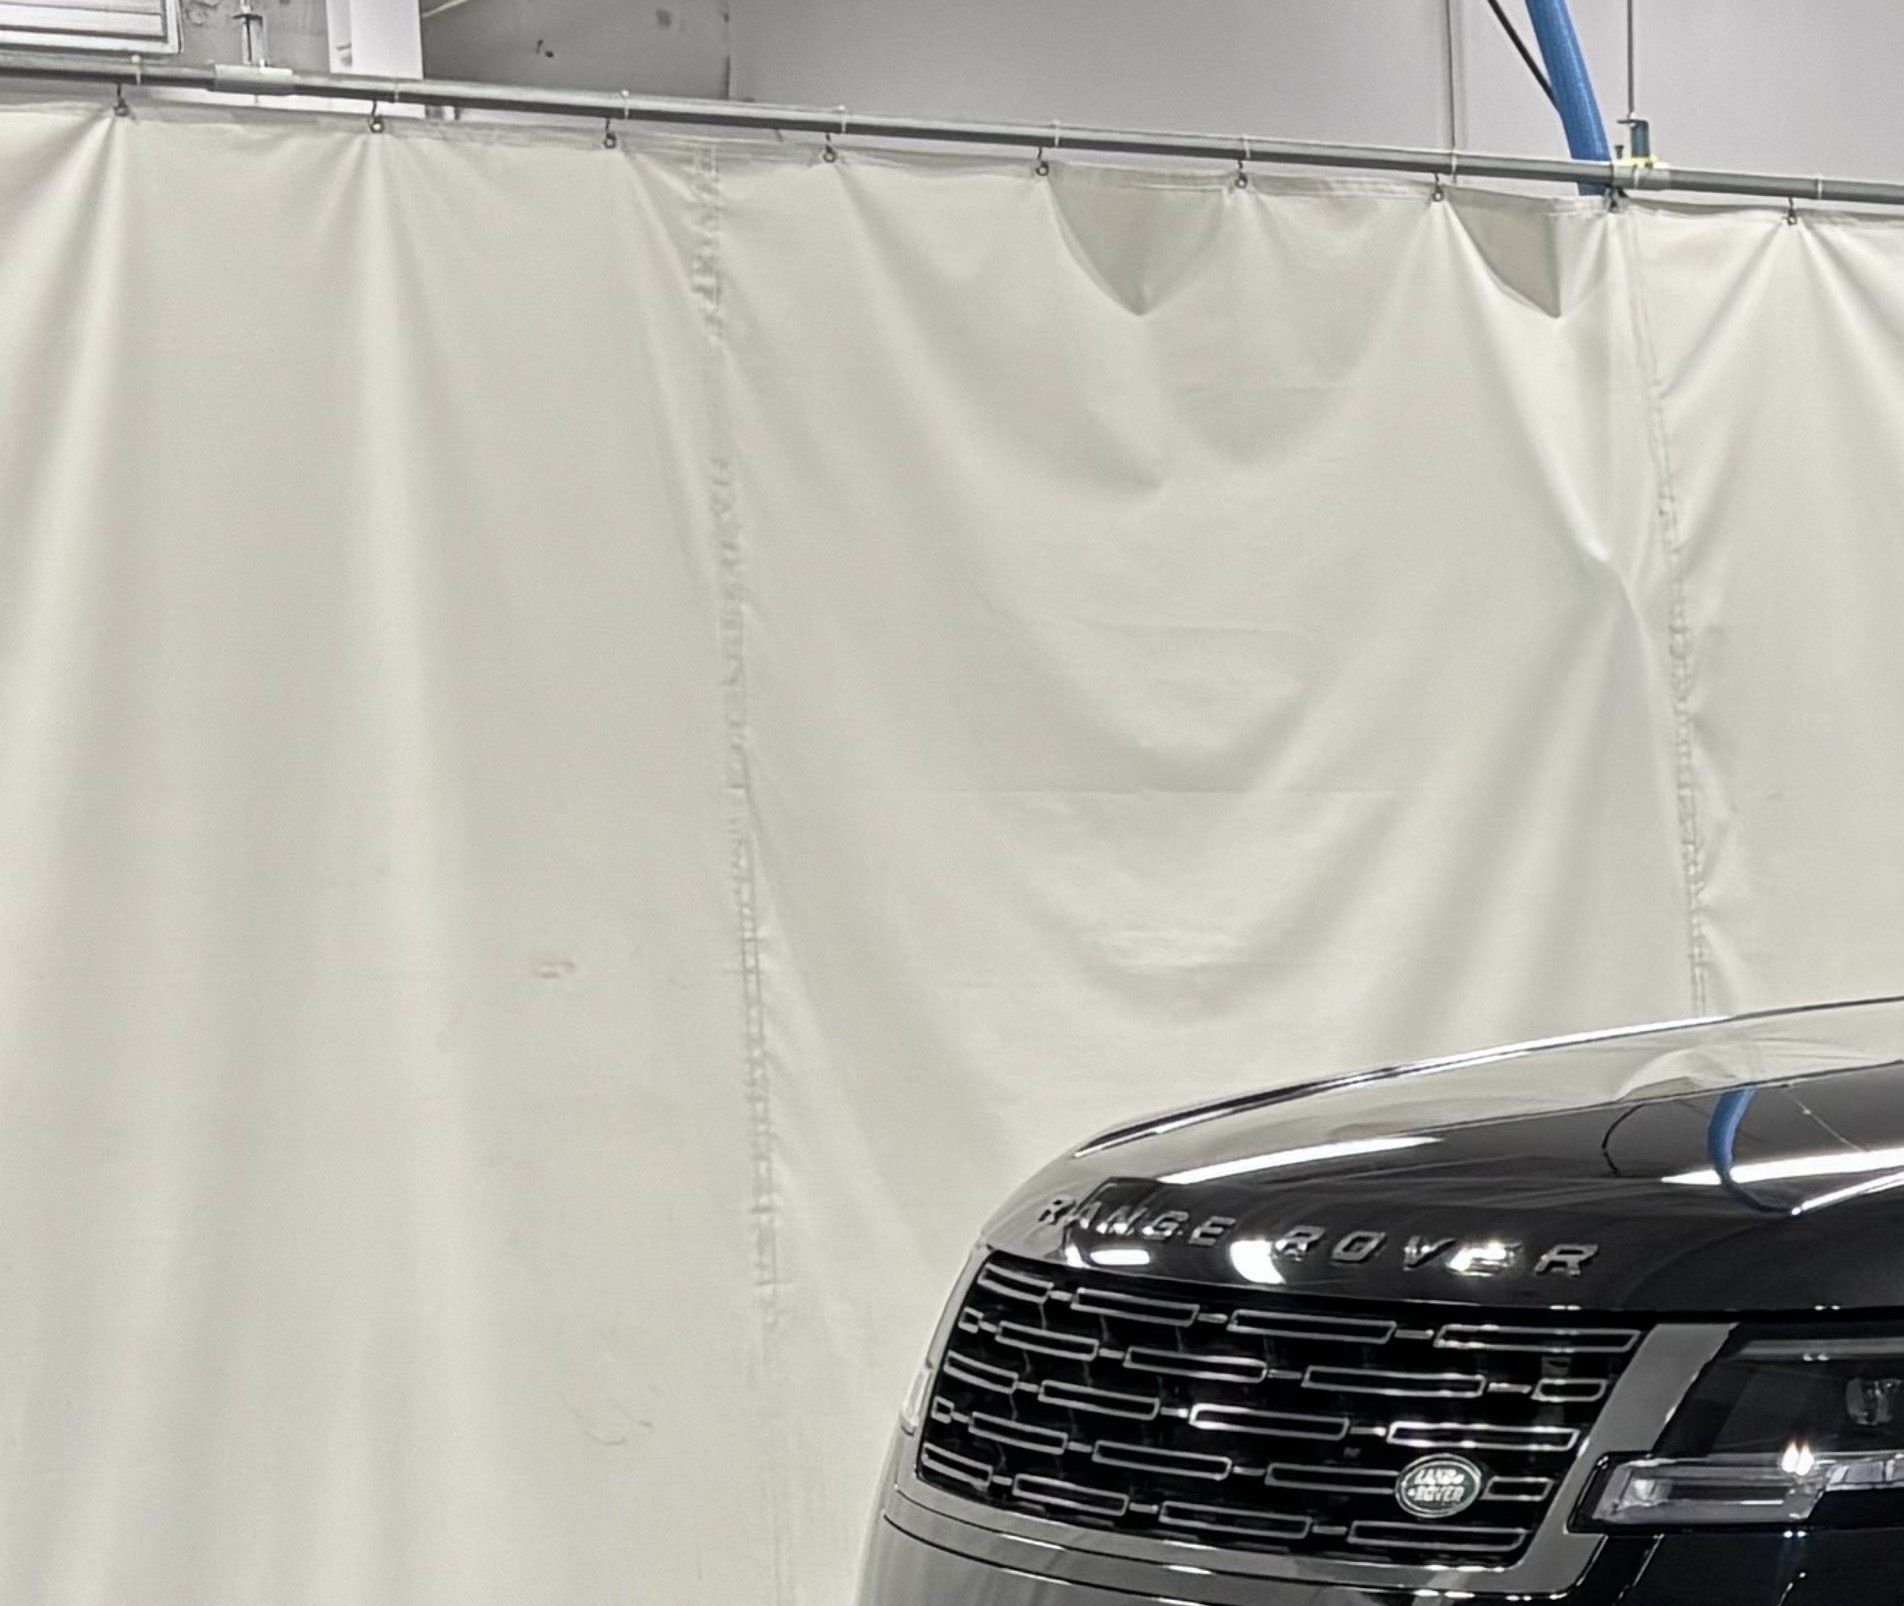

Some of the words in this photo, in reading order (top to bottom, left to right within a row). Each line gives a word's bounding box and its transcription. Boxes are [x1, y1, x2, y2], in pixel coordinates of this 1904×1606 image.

[1038, 1197, 1237, 1248] RANGE
[1273, 1225, 1598, 1276] ROVER
[1414, 1469, 1457, 1485] LAND
[1415, 1486, 1465, 1502] ROVER
